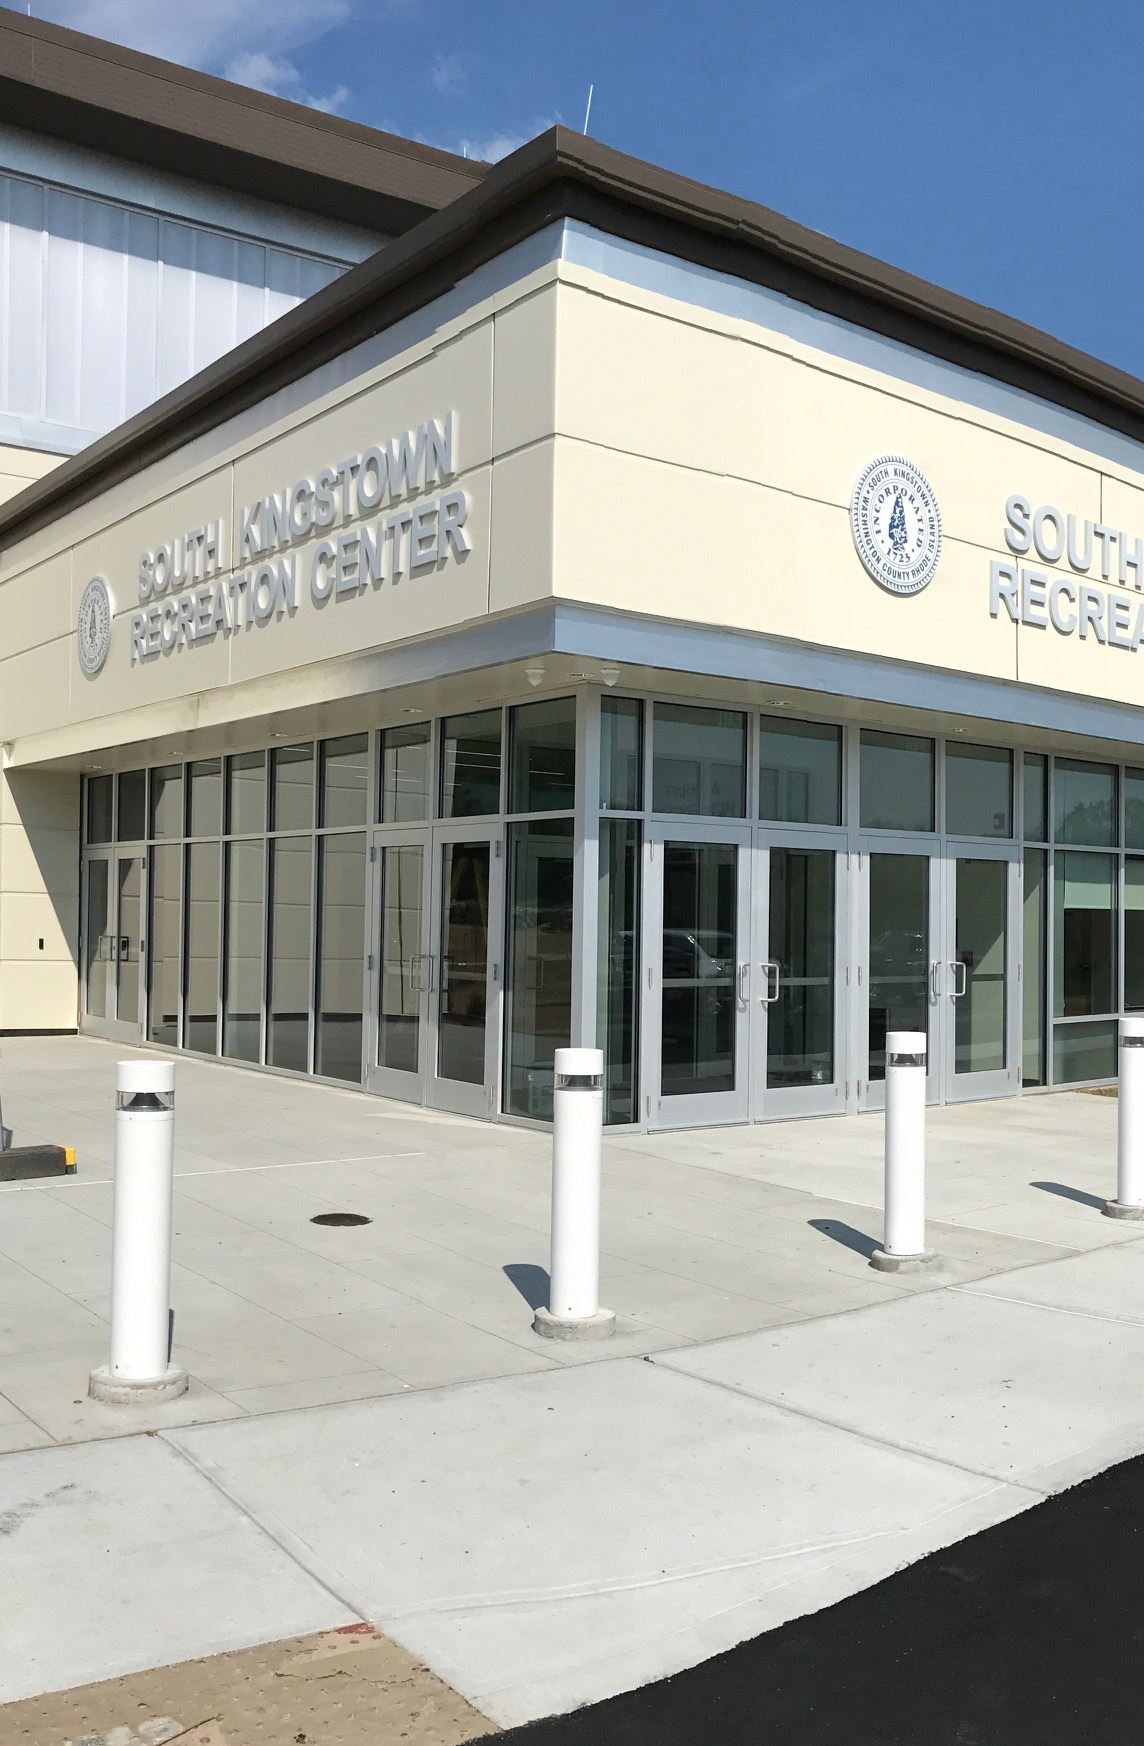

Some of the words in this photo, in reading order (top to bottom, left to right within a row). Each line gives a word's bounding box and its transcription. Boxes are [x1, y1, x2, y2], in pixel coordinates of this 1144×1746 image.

[138, 518, 225, 600] SOUTH
[240, 409, 460, 560] KINGSTOWN
[867, 467, 889, 491] SOUTH
[893, 467, 930, 508] KINGSTOWN
[872, 485, 925, 548] INCORPORATED
[130, 554, 299, 665] RECREATION
[310, 490, 471, 604] CENTER
[861, 496, 882, 565] WASHINGTON
[882, 562, 910, 581] COUNTY
[911, 553, 931, 579] RHODE
[927, 516, 936, 554] ISLAND
[886, 547, 911, 563] 1723
[1003, 494, 1143, 591] SOUTH
